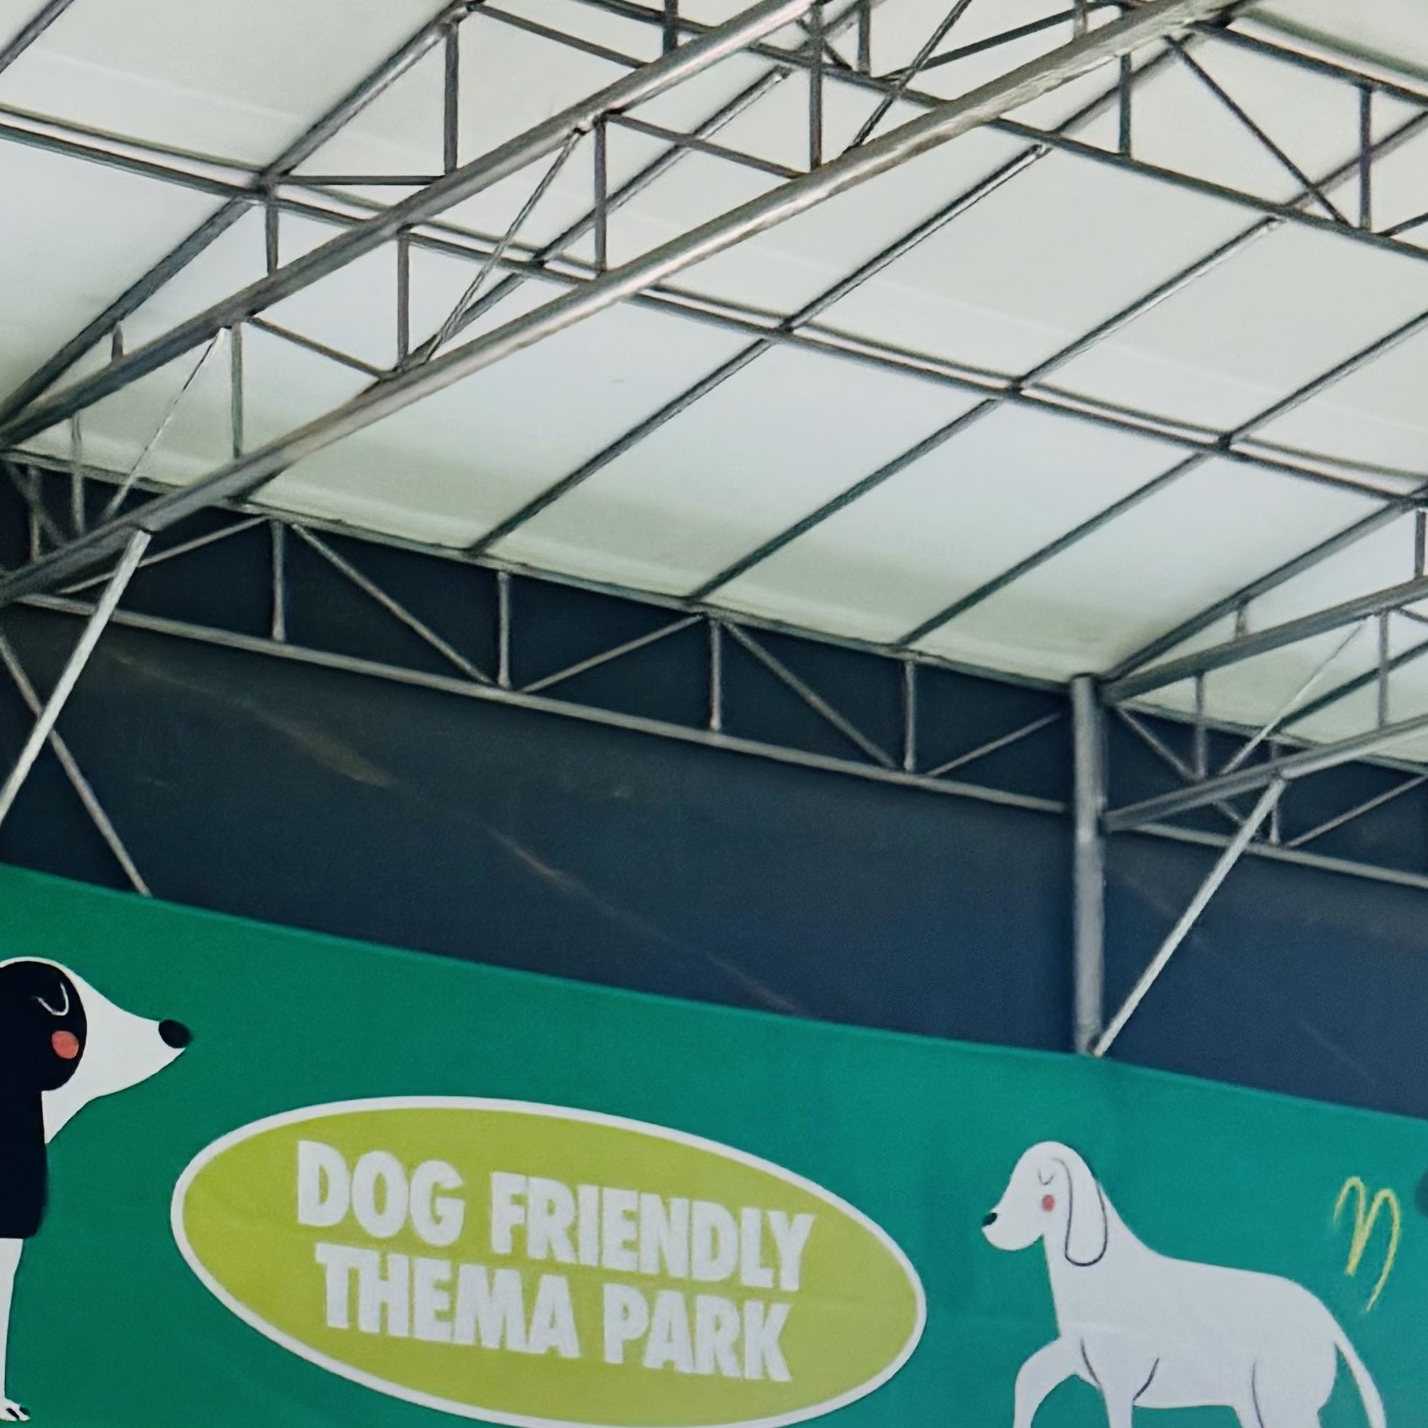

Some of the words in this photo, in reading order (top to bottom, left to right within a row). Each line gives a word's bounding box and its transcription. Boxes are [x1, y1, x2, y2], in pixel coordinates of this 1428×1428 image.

[296, 1140, 466, 1248] DOG
[490, 1171, 816, 1292] FRIENDLY
[314, 1242, 581, 1360] THEMA
[602, 1283, 793, 1383] PARK
